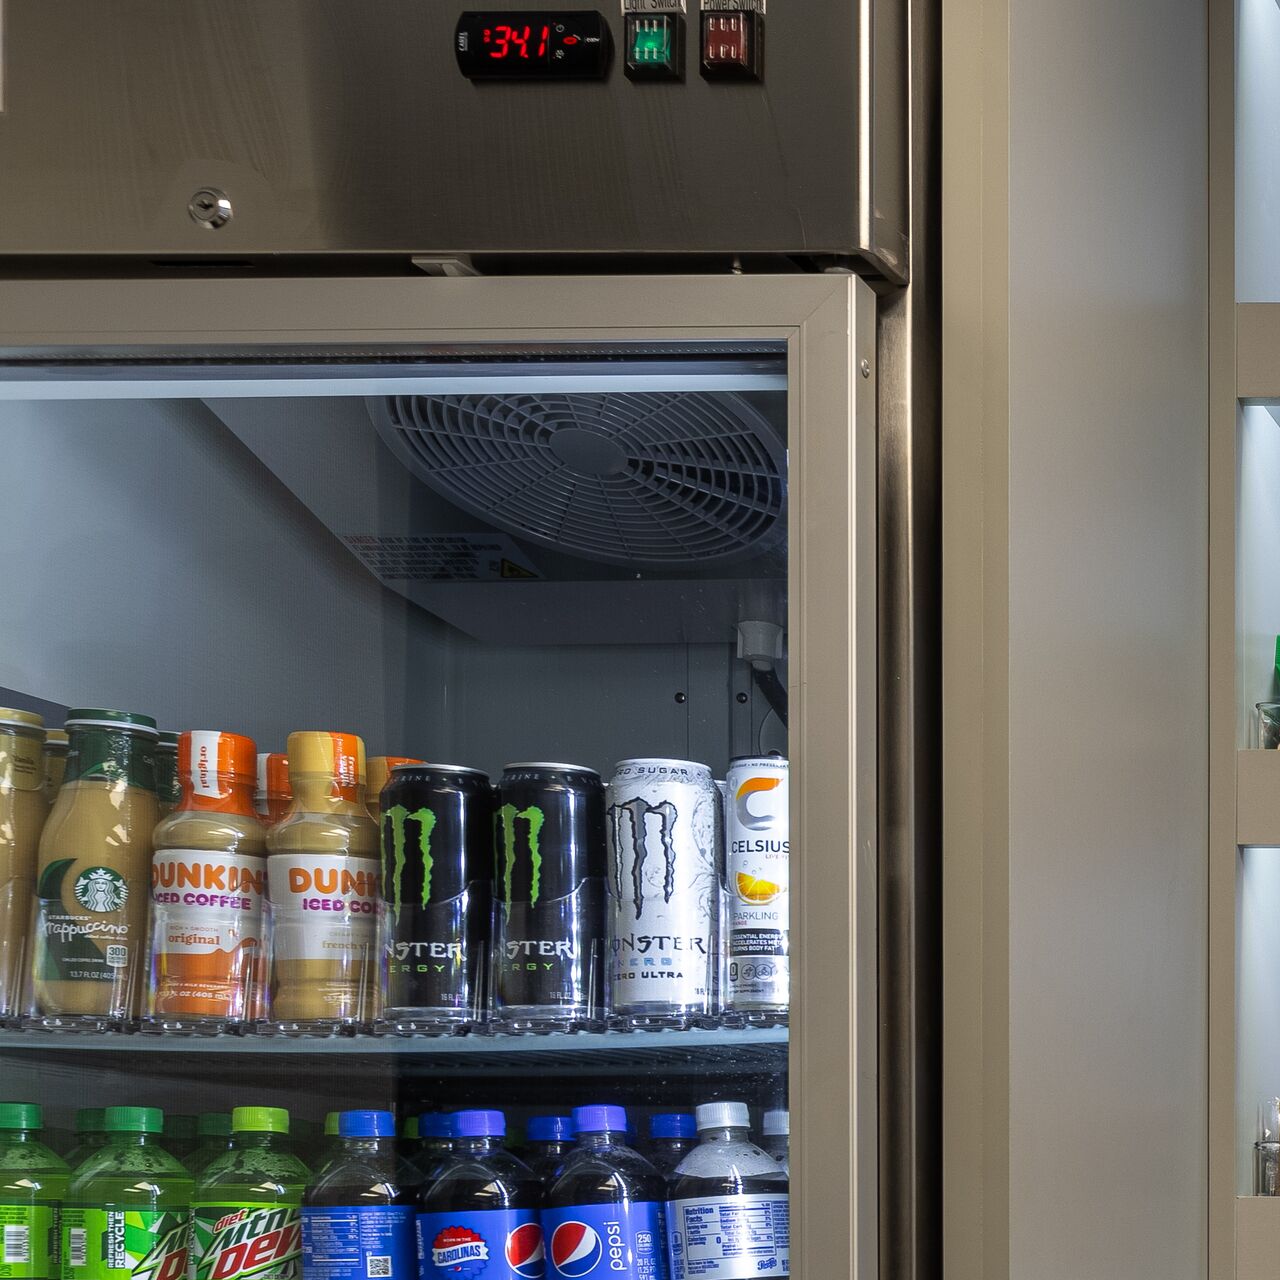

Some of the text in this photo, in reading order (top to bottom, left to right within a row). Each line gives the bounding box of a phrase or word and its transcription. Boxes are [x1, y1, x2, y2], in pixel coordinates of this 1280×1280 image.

[199, 746, 208, 789] original
[636, 766, 688, 776] SUGAR
[184, 892, 252, 911] COFFEE
[302, 899, 346, 912] ICED
[168, 933, 220, 948] original
[108, 947, 126, 957] 300
[641, 970, 684, 980] ULTRA
[686, 1207, 714, 1215] Nutrition
[214, 1209, 248, 1232] diet
[115, 1212, 126, 1269] RECYCLE
[604, 1220, 628, 1271] pepsi
[637, 1233, 652, 1243] 250
[436, 1244, 482, 1267] CAROLINAS
